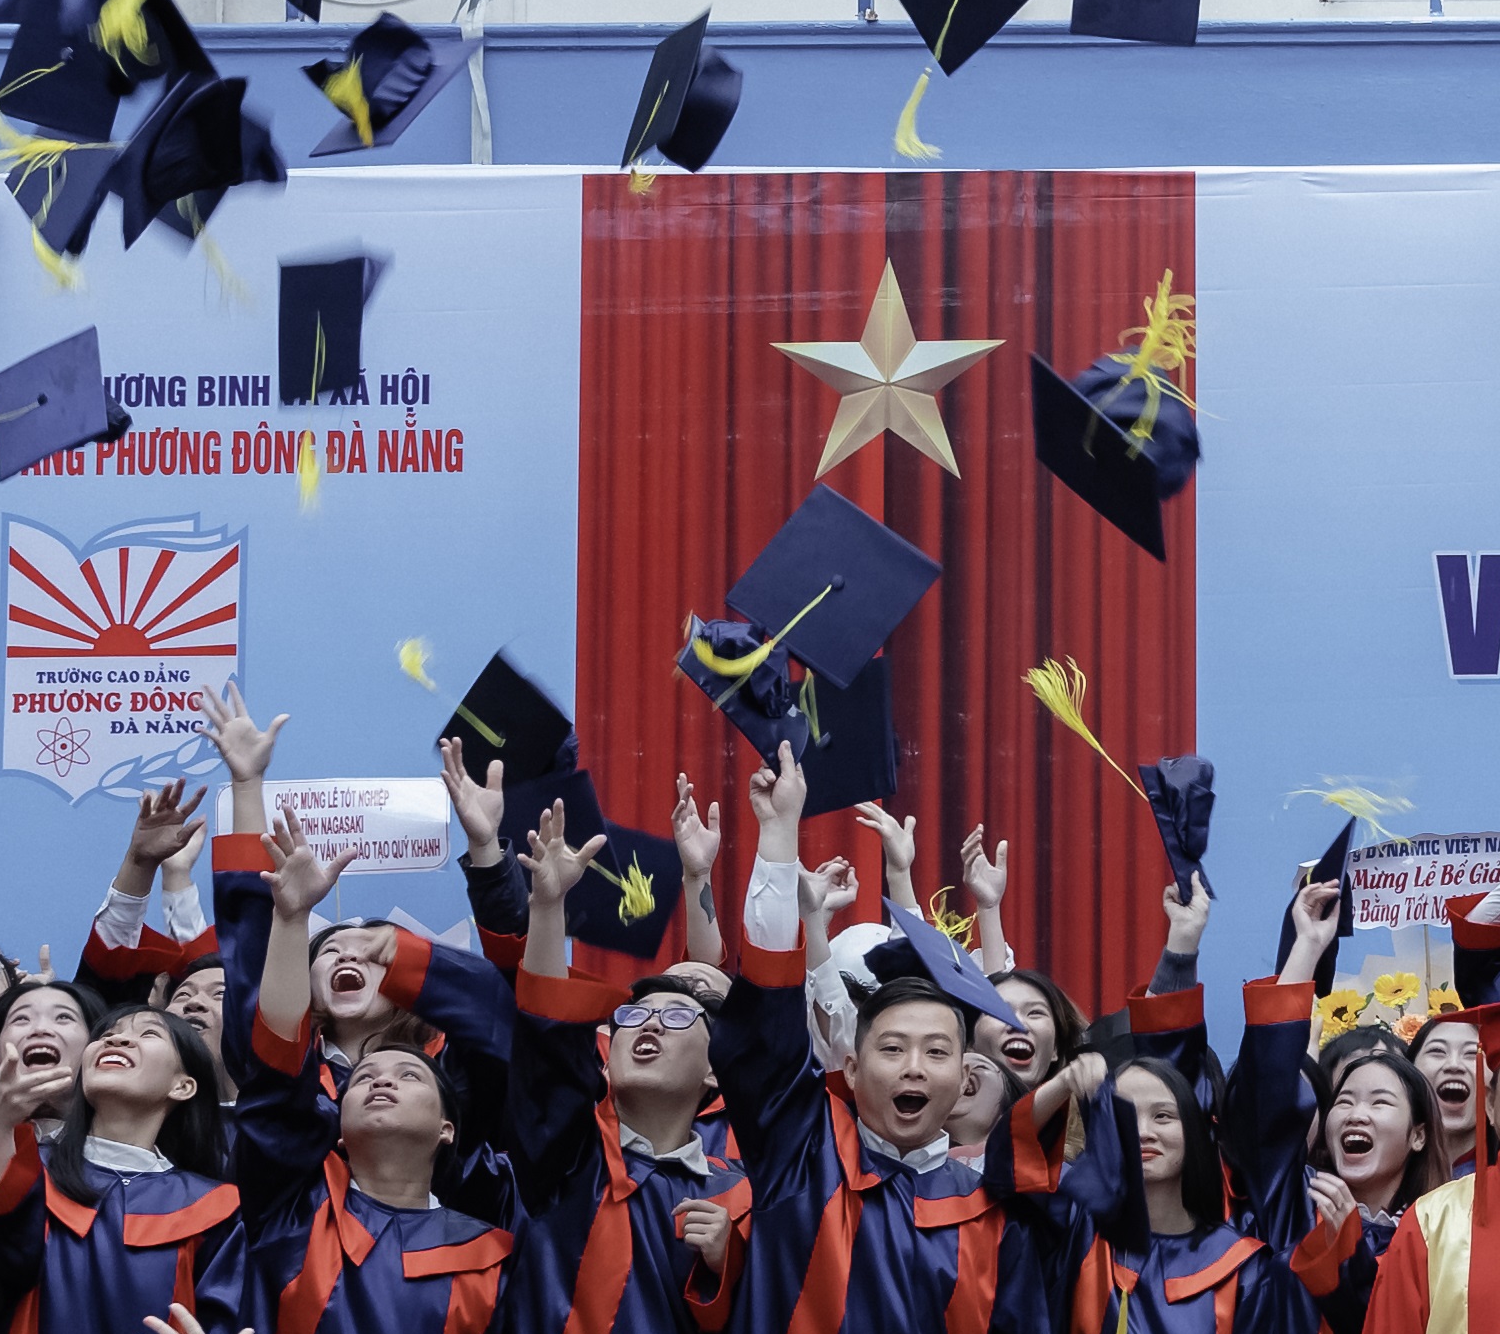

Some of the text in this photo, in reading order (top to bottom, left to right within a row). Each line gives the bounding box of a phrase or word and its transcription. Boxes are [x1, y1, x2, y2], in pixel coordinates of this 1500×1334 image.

[197, 375, 271, 407] BINH
[380, 367, 430, 413] HỘI
[95, 427, 222, 476] PHƯƠNG
[231, 421, 316, 475] ĐÔNG
[326, 420, 367, 474] ĐÀ
[378, 413, 463, 473] NẴNG
[36, 662, 191, 684] TRƯỜNG CAO ĐẲNG
[12, 686, 204, 713] PHƯƠNG ĐÔNG
[110, 716, 140, 734] ĐÀ
[275, 788, 299, 811] CHÚC
[300, 787, 326, 810] MỪNG
[321, 815, 365, 835] NAGASAKI
[372, 840, 390, 864] TẠO
[411, 839, 442, 857] KHANH
[1366, 839, 1441, 859] DYNAMIC
[1444, 836, 1480, 857] VIỆT
[1352, 865, 1409, 894] Mừng
[1414, 860, 1437, 887] Lễ
[1440, 860, 1469, 886] Bế
[1360, 892, 1400, 927] Bằng
[1405, 892, 1429, 921] Tốt
